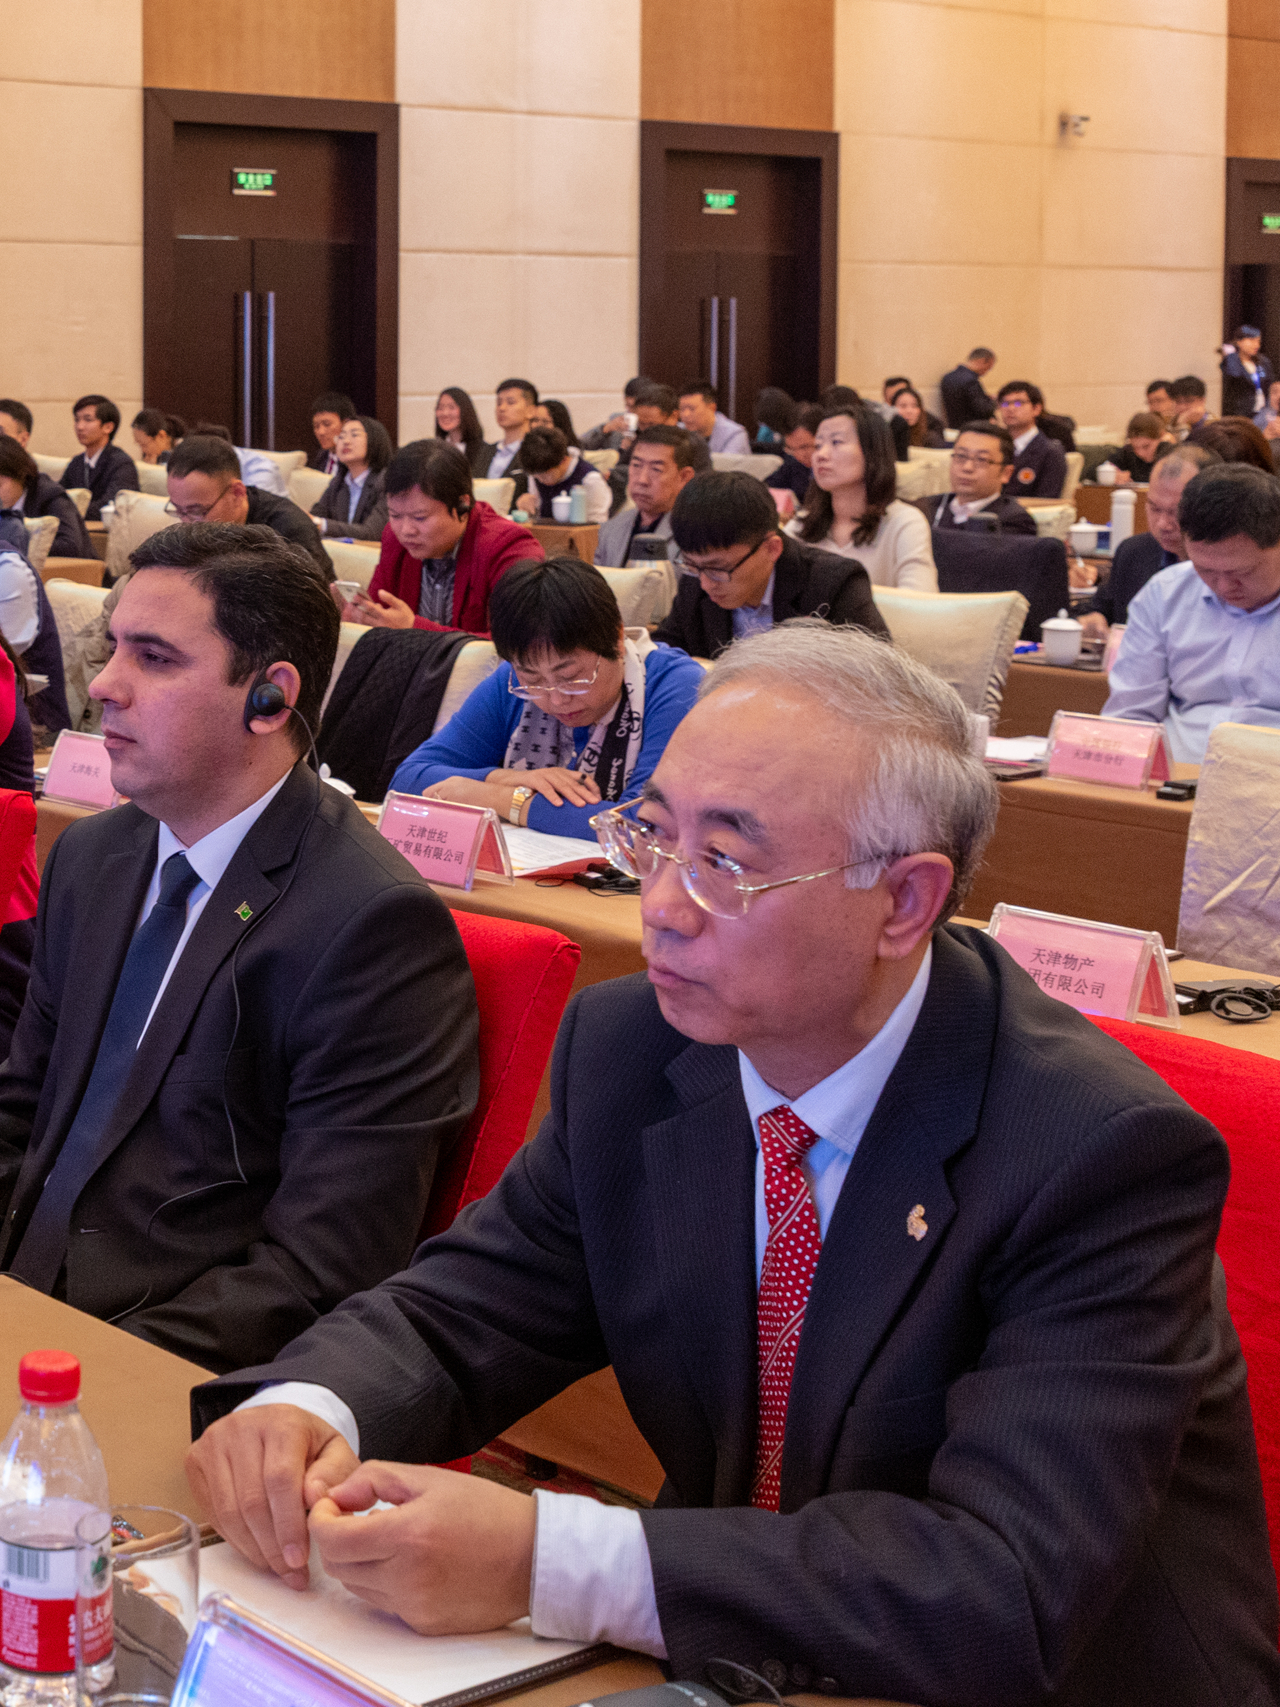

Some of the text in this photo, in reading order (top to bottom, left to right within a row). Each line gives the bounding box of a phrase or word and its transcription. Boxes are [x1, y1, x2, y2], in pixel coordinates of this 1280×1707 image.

[406, 824, 449, 844] 天津世纪
[386, 837, 465, 865] 矿贸易有限公司
[1030, 947, 1095, 972] 天津物产
